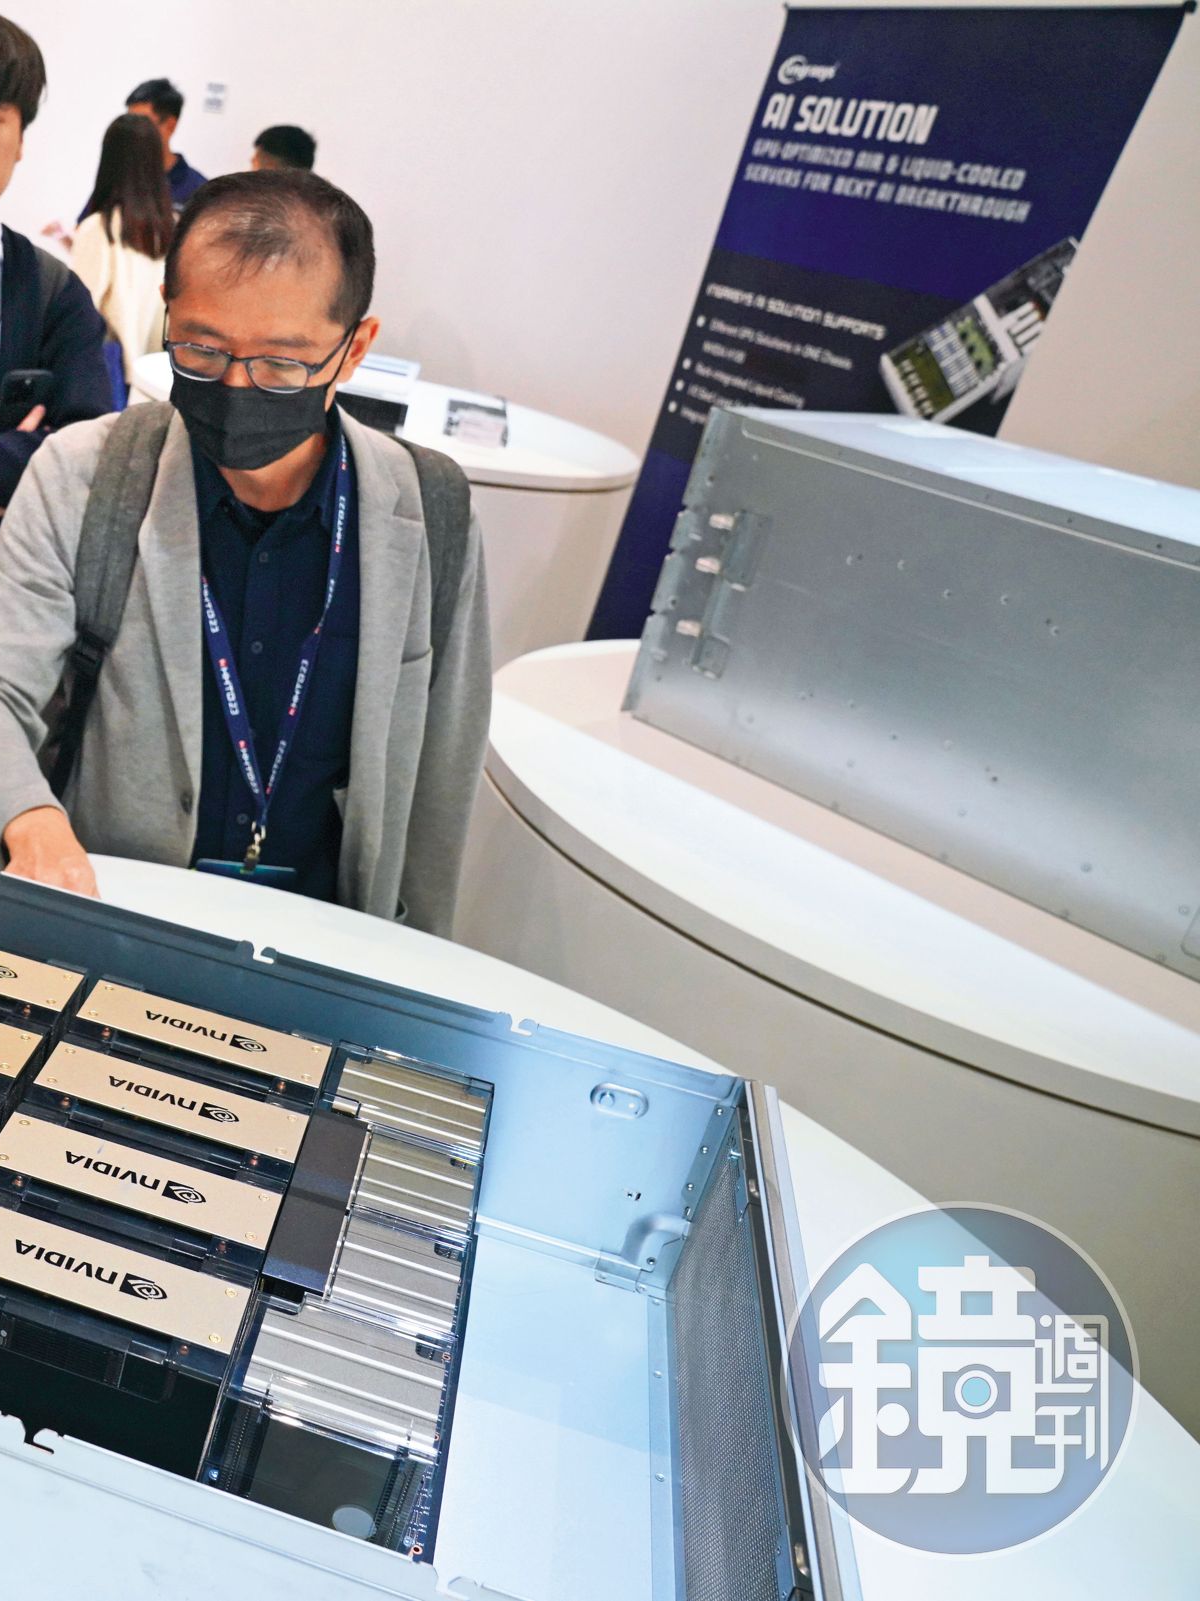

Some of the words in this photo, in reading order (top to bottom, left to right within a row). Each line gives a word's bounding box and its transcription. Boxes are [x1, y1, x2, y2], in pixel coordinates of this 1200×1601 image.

[762, 93, 795, 130] AI
[793, 95, 939, 145] SOLUTION
[854, 151, 885, 173] AIR
[900, 156, 1027, 191] LIQUID-COOLED
[802, 171, 831, 192] FOR
[832, 175, 877, 200] NEXT
[895, 184, 1032, 223] BREAKTHROUGH
[145, 1009, 228, 1042] NVIDIA
[108, 1075, 197, 1111] NVIDIA
[65, 1150, 161, 1191] NVIDIA
[15, 1238, 119, 1285] NVIDIA
